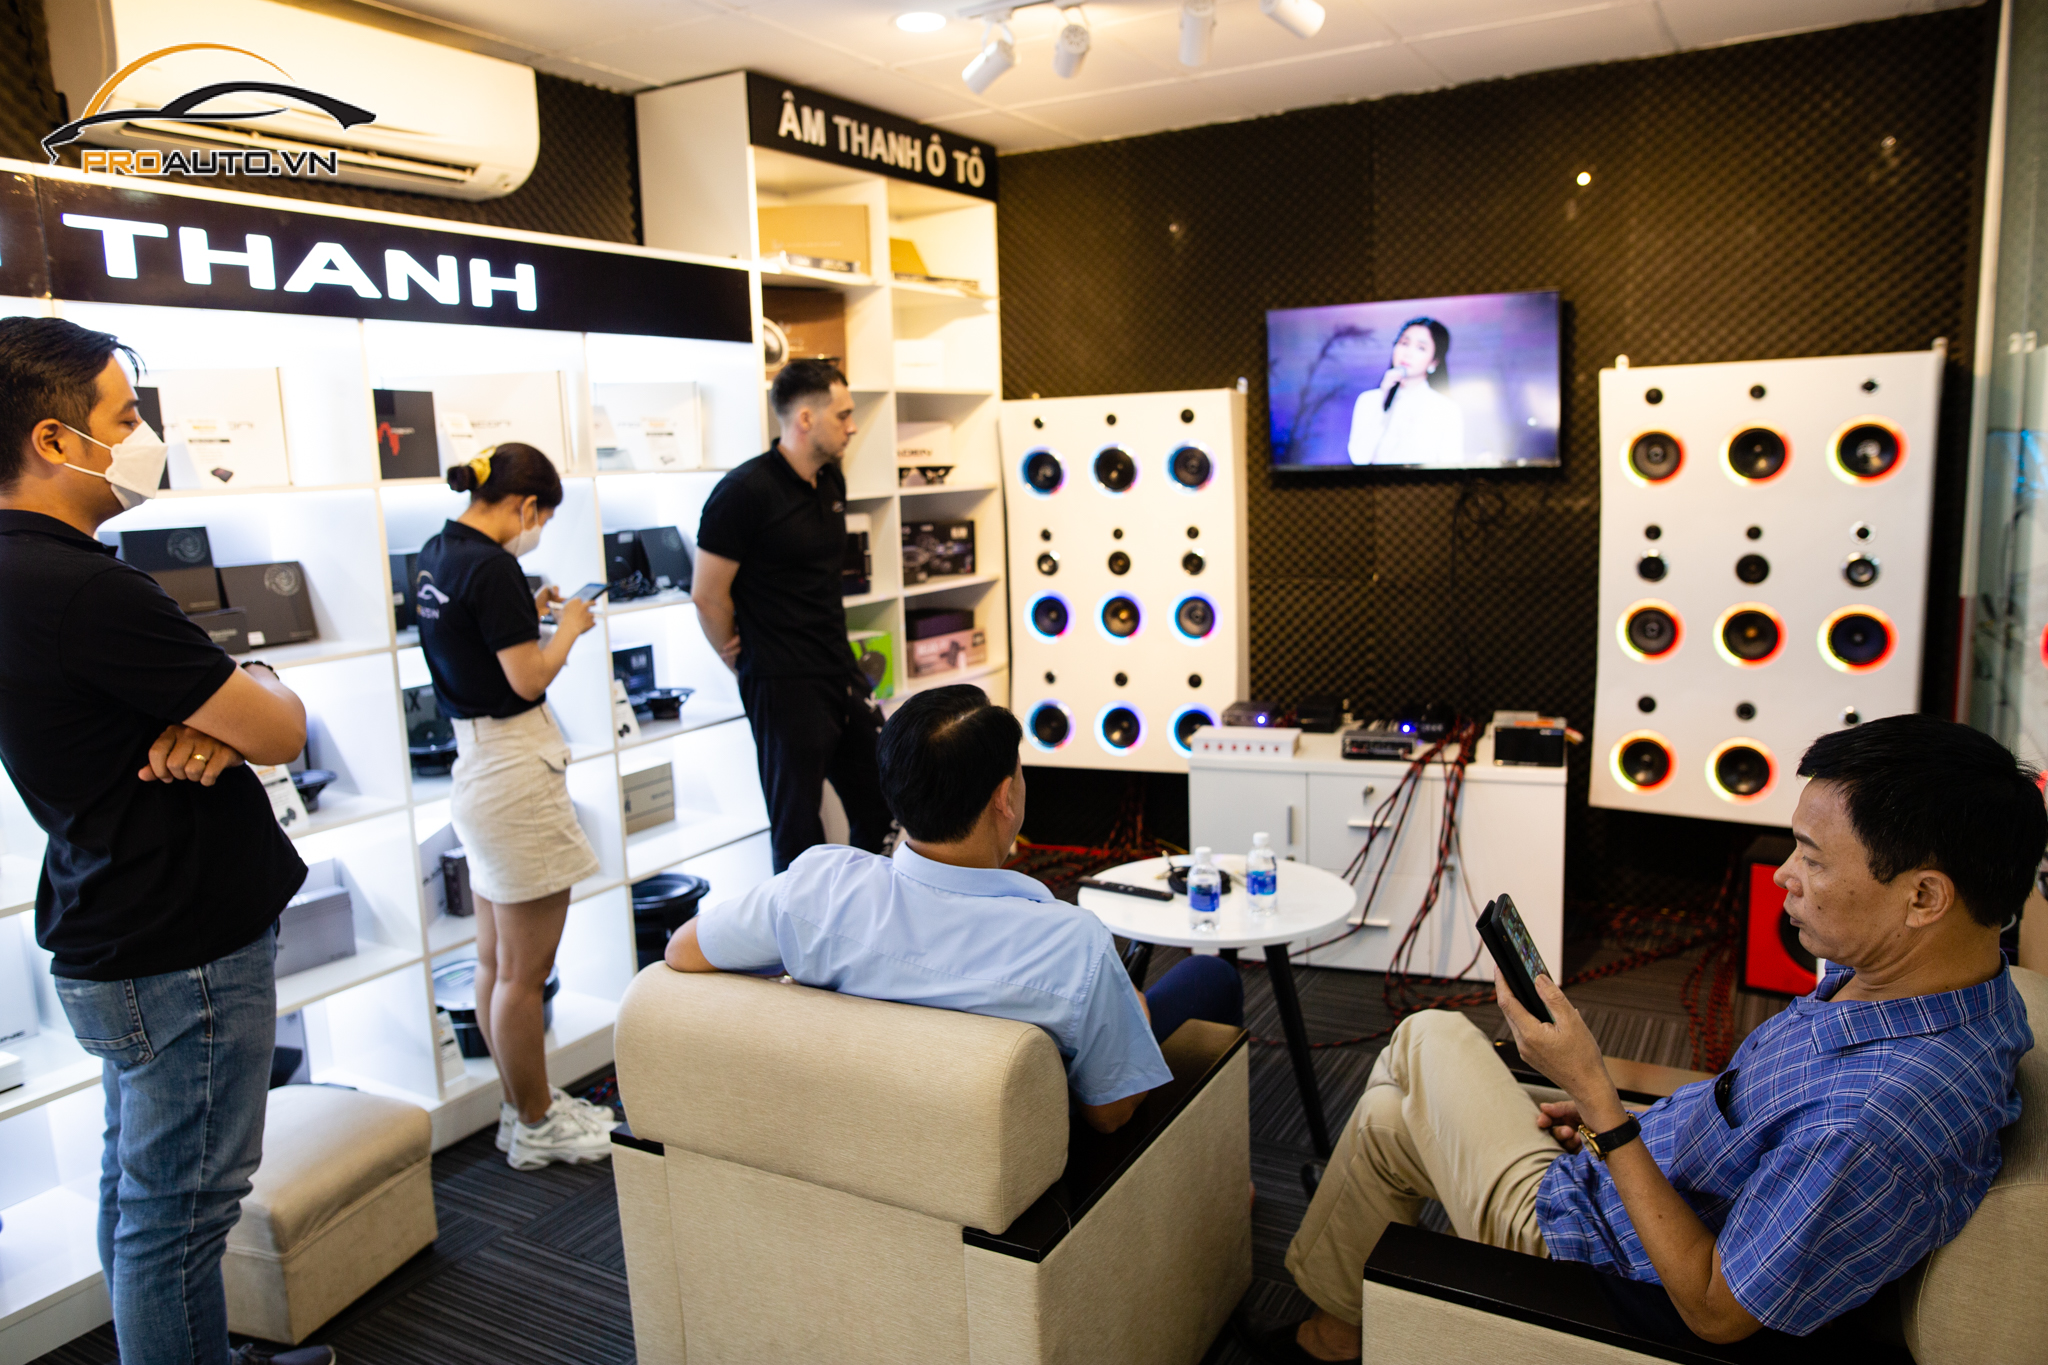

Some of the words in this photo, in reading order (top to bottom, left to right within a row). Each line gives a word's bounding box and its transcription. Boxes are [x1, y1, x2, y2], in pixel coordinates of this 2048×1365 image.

[778, 90, 827, 147] ÂM
[833, 115, 922, 172] THANH
[925, 133, 947, 177] Ô
[952, 146, 986, 188] TÔ
[63, 213, 537, 311] THANH
